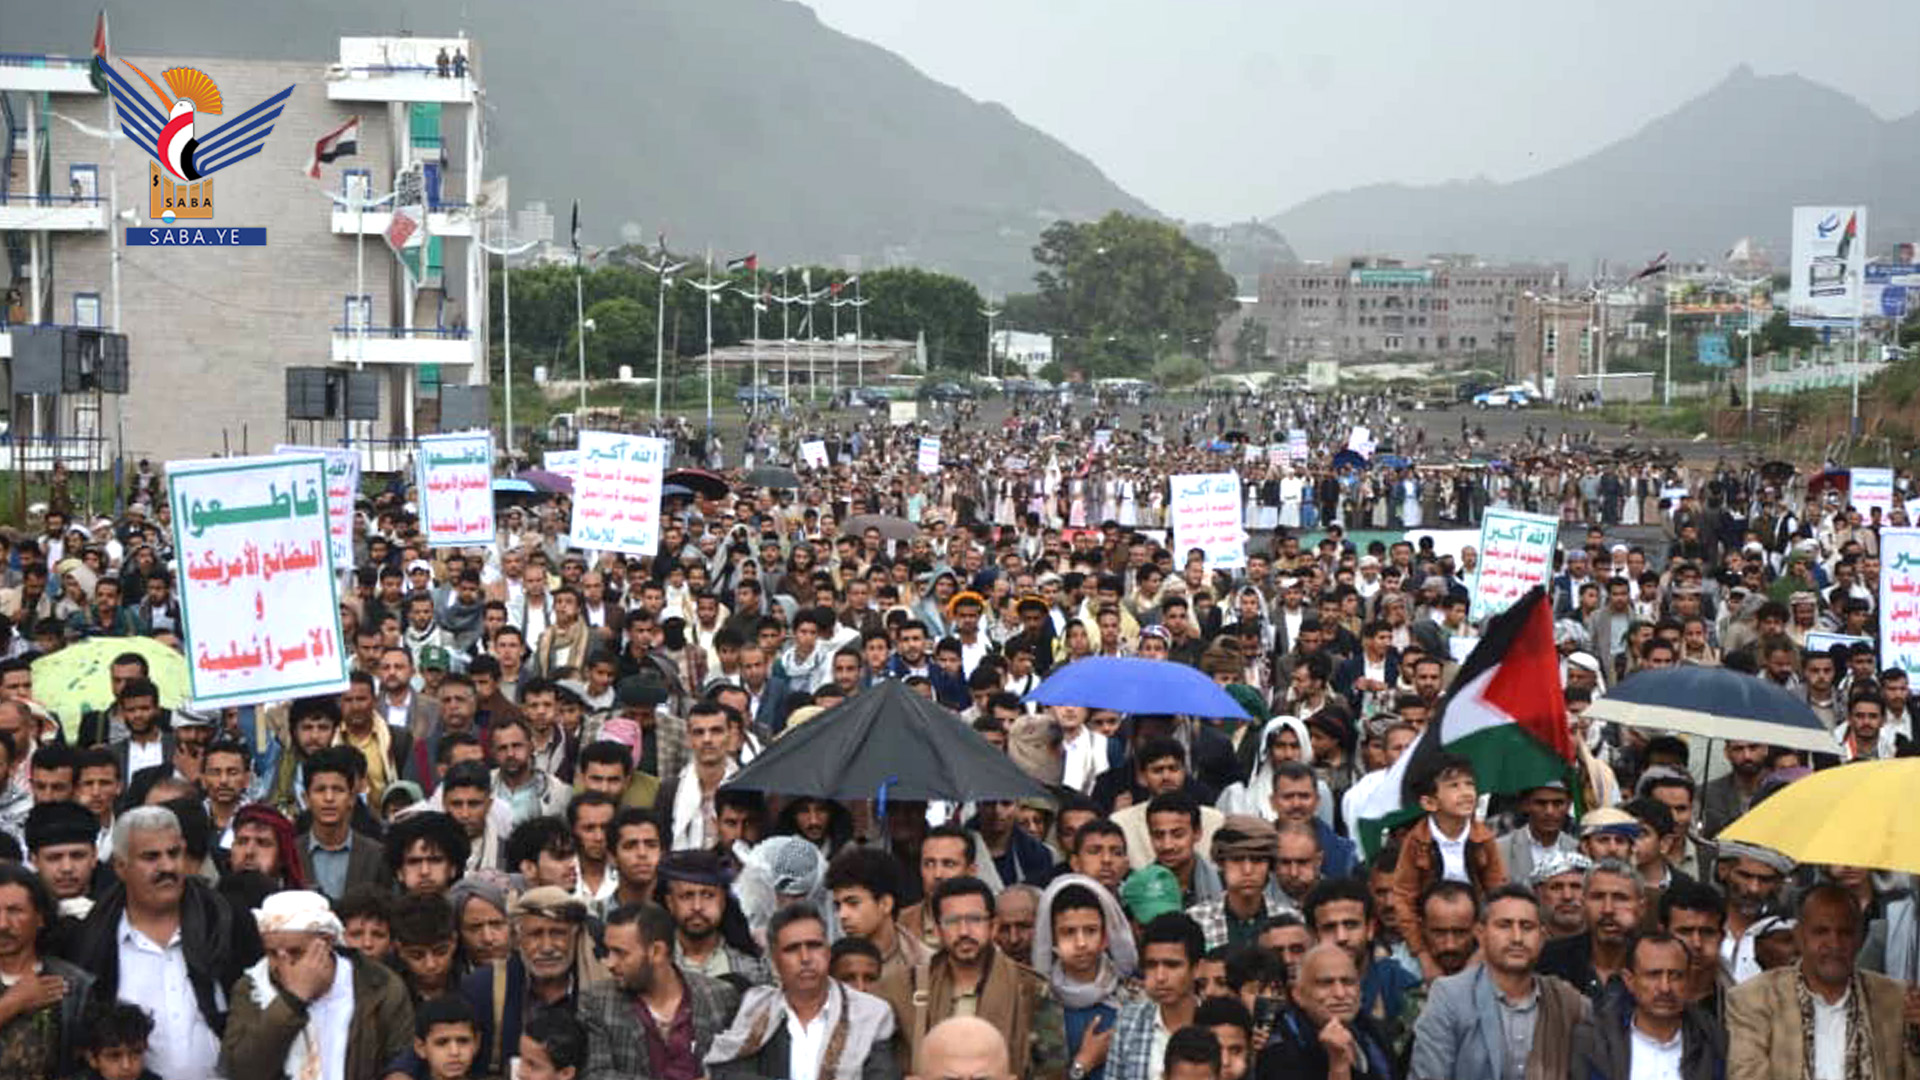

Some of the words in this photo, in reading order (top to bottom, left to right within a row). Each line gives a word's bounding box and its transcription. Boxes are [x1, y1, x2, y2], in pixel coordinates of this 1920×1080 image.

[181, 478, 319, 538] قاطعوا
[1487, 524, 1528, 547] أكبر
[1526, 528, 1552, 545] الله
[187, 540, 260, 589] الأمريكية
[263, 540, 323, 581] البضائع
[256, 590, 264, 620] و
[197, 628, 334, 678] الإسرائيلية
